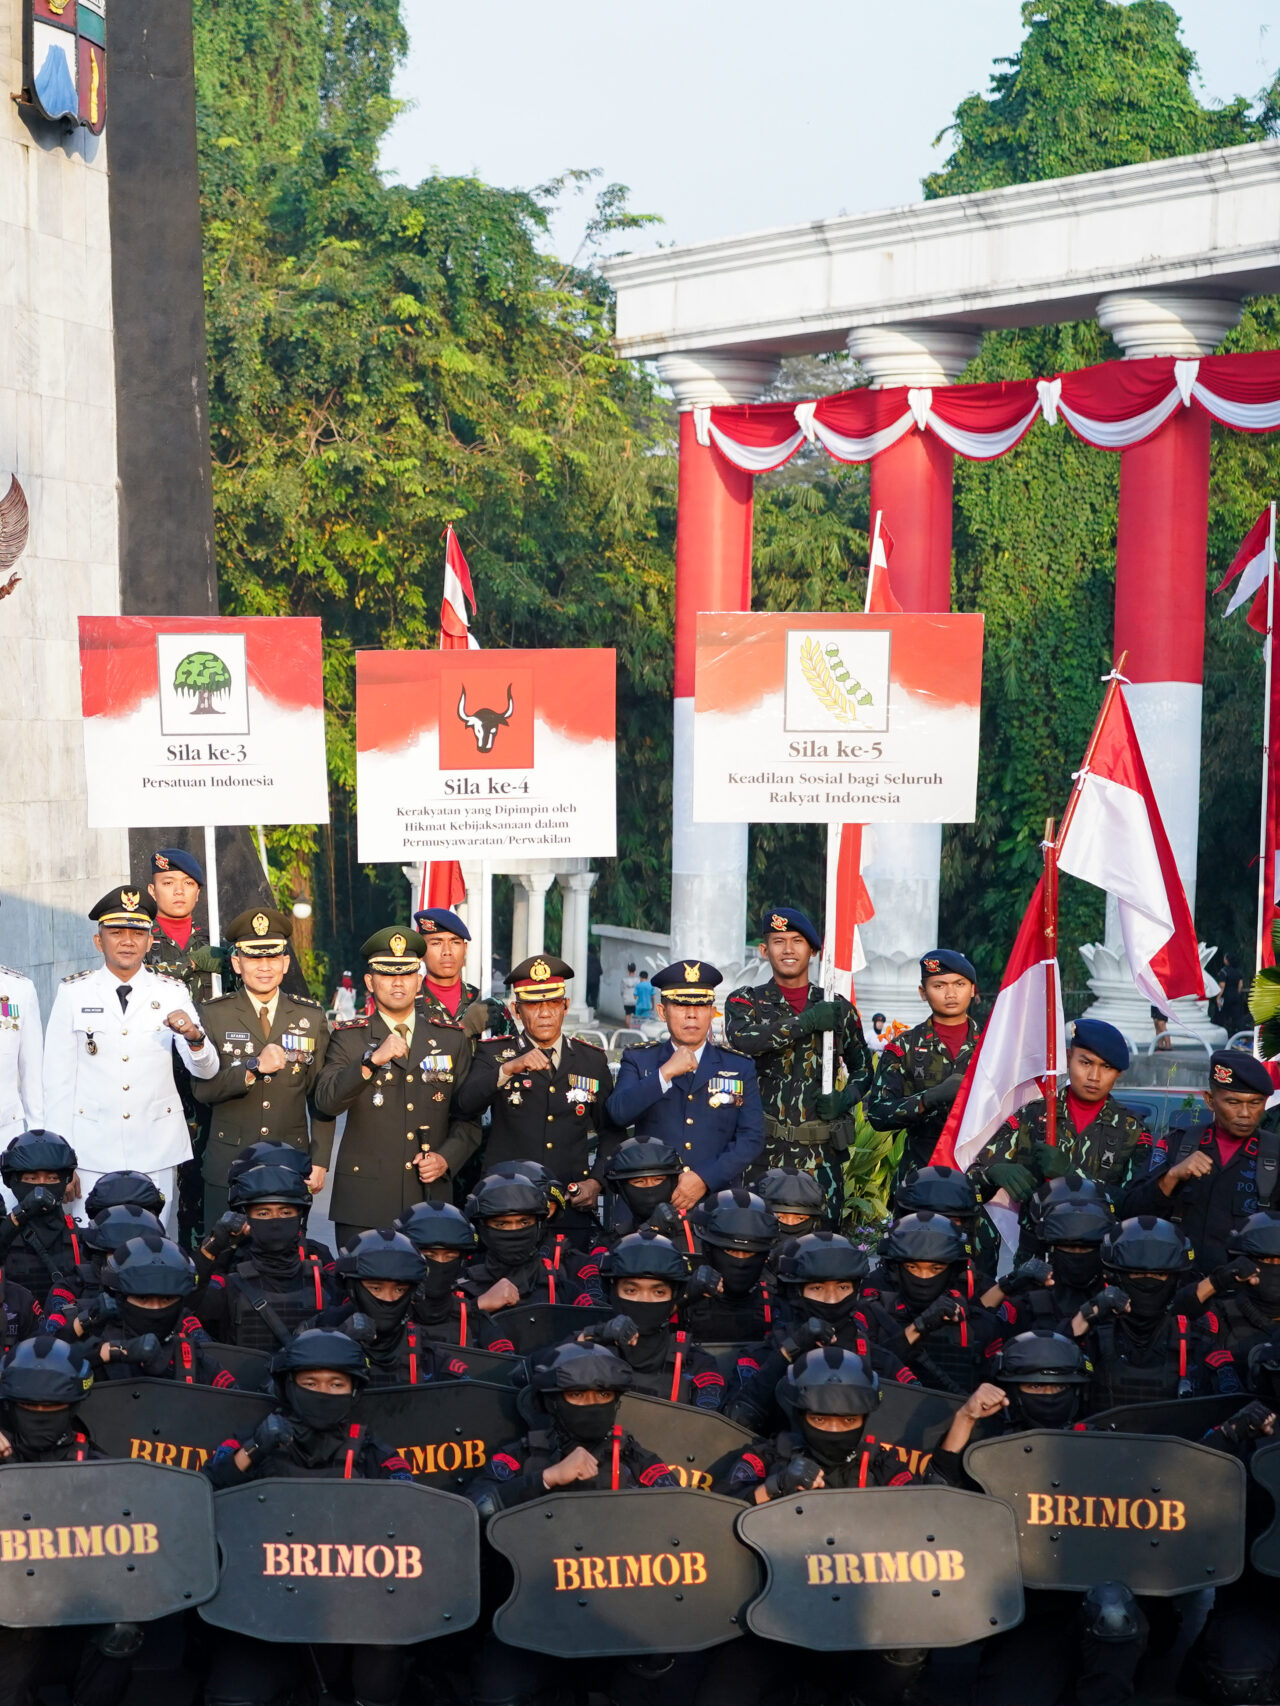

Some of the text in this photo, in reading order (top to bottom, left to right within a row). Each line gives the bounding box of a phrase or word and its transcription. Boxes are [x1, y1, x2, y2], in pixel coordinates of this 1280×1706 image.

[166, 743, 248, 763] Sila ke-3
[788, 739, 883, 760] Sila ke-5
[142, 775, 274, 789] Persatuan Indonesia
[444, 776, 530, 796] Sila ke-4
[728, 772, 943, 788] Keadilan Sosial bagi Seluruh
[769, 791, 901, 807] Rakyat Indonesia
[396, 803, 577, 820] Kerakyatan yang Dipimpin oleh
[405, 818, 569, 833] Hikmat Kebijaksanaan dalam
[130, 1438, 216, 1471] BRI
[393, 1439, 486, 1475] IMOB
[1026, 1492, 1187, 1533] BRIMOB
[262, 1542, 423, 1579] BRIMOB
[806, 1549, 966, 1586] BRIMOB
[552, 1551, 709, 1591] BRIMOB
